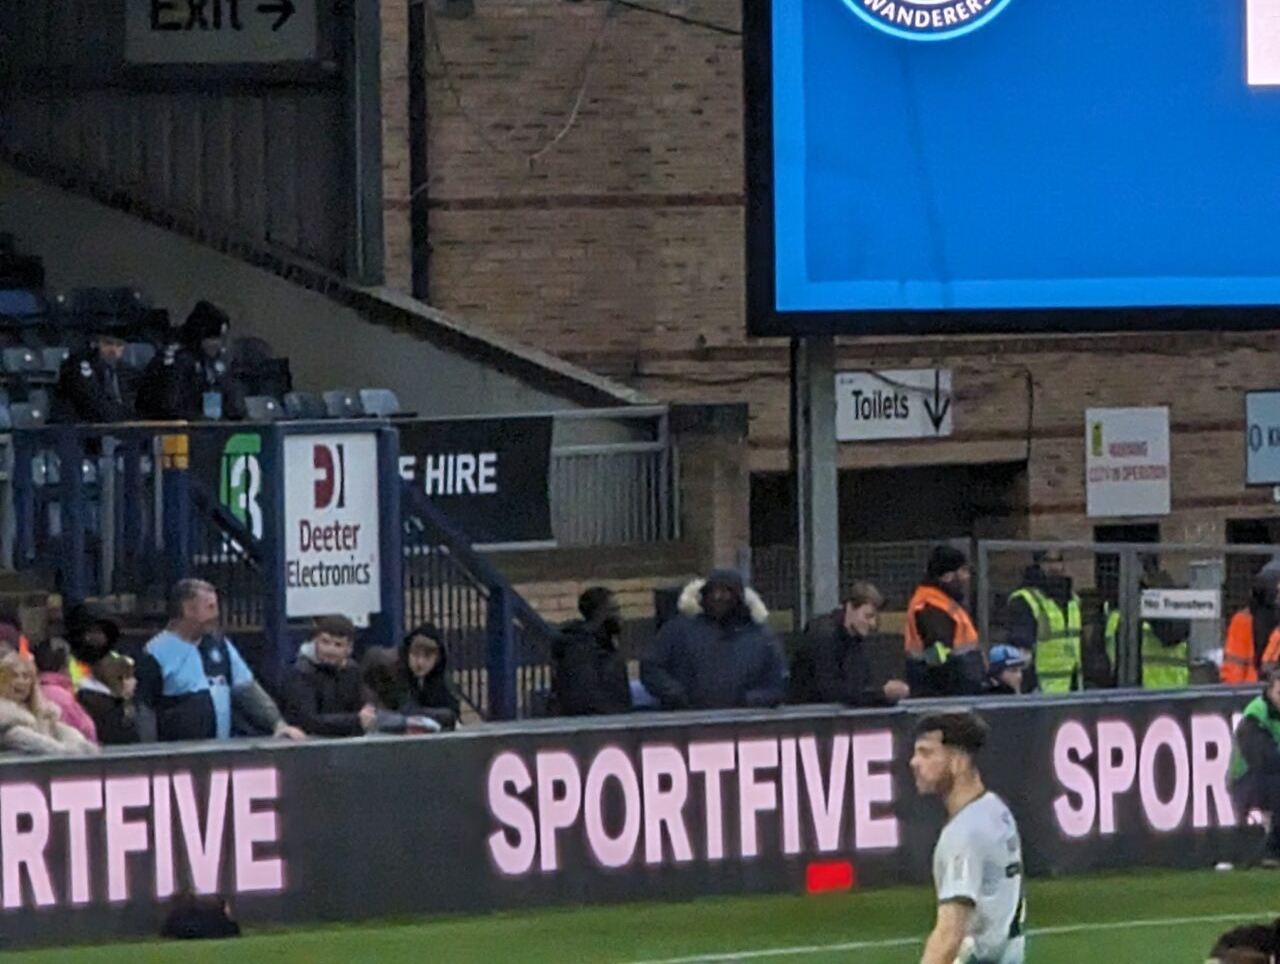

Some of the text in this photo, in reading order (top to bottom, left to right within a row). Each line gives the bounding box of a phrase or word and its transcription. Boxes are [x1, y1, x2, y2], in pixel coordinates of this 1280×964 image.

[851, 389, 910, 421] Toilets
[425, 452, 498, 496] HIRE
[299, 518, 361, 553] Deeter
[286, 555, 372, 589] Electronics
[487, 731, 899, 875] SPORTFIVE
[0, 767, 284, 907] RTFIVE
